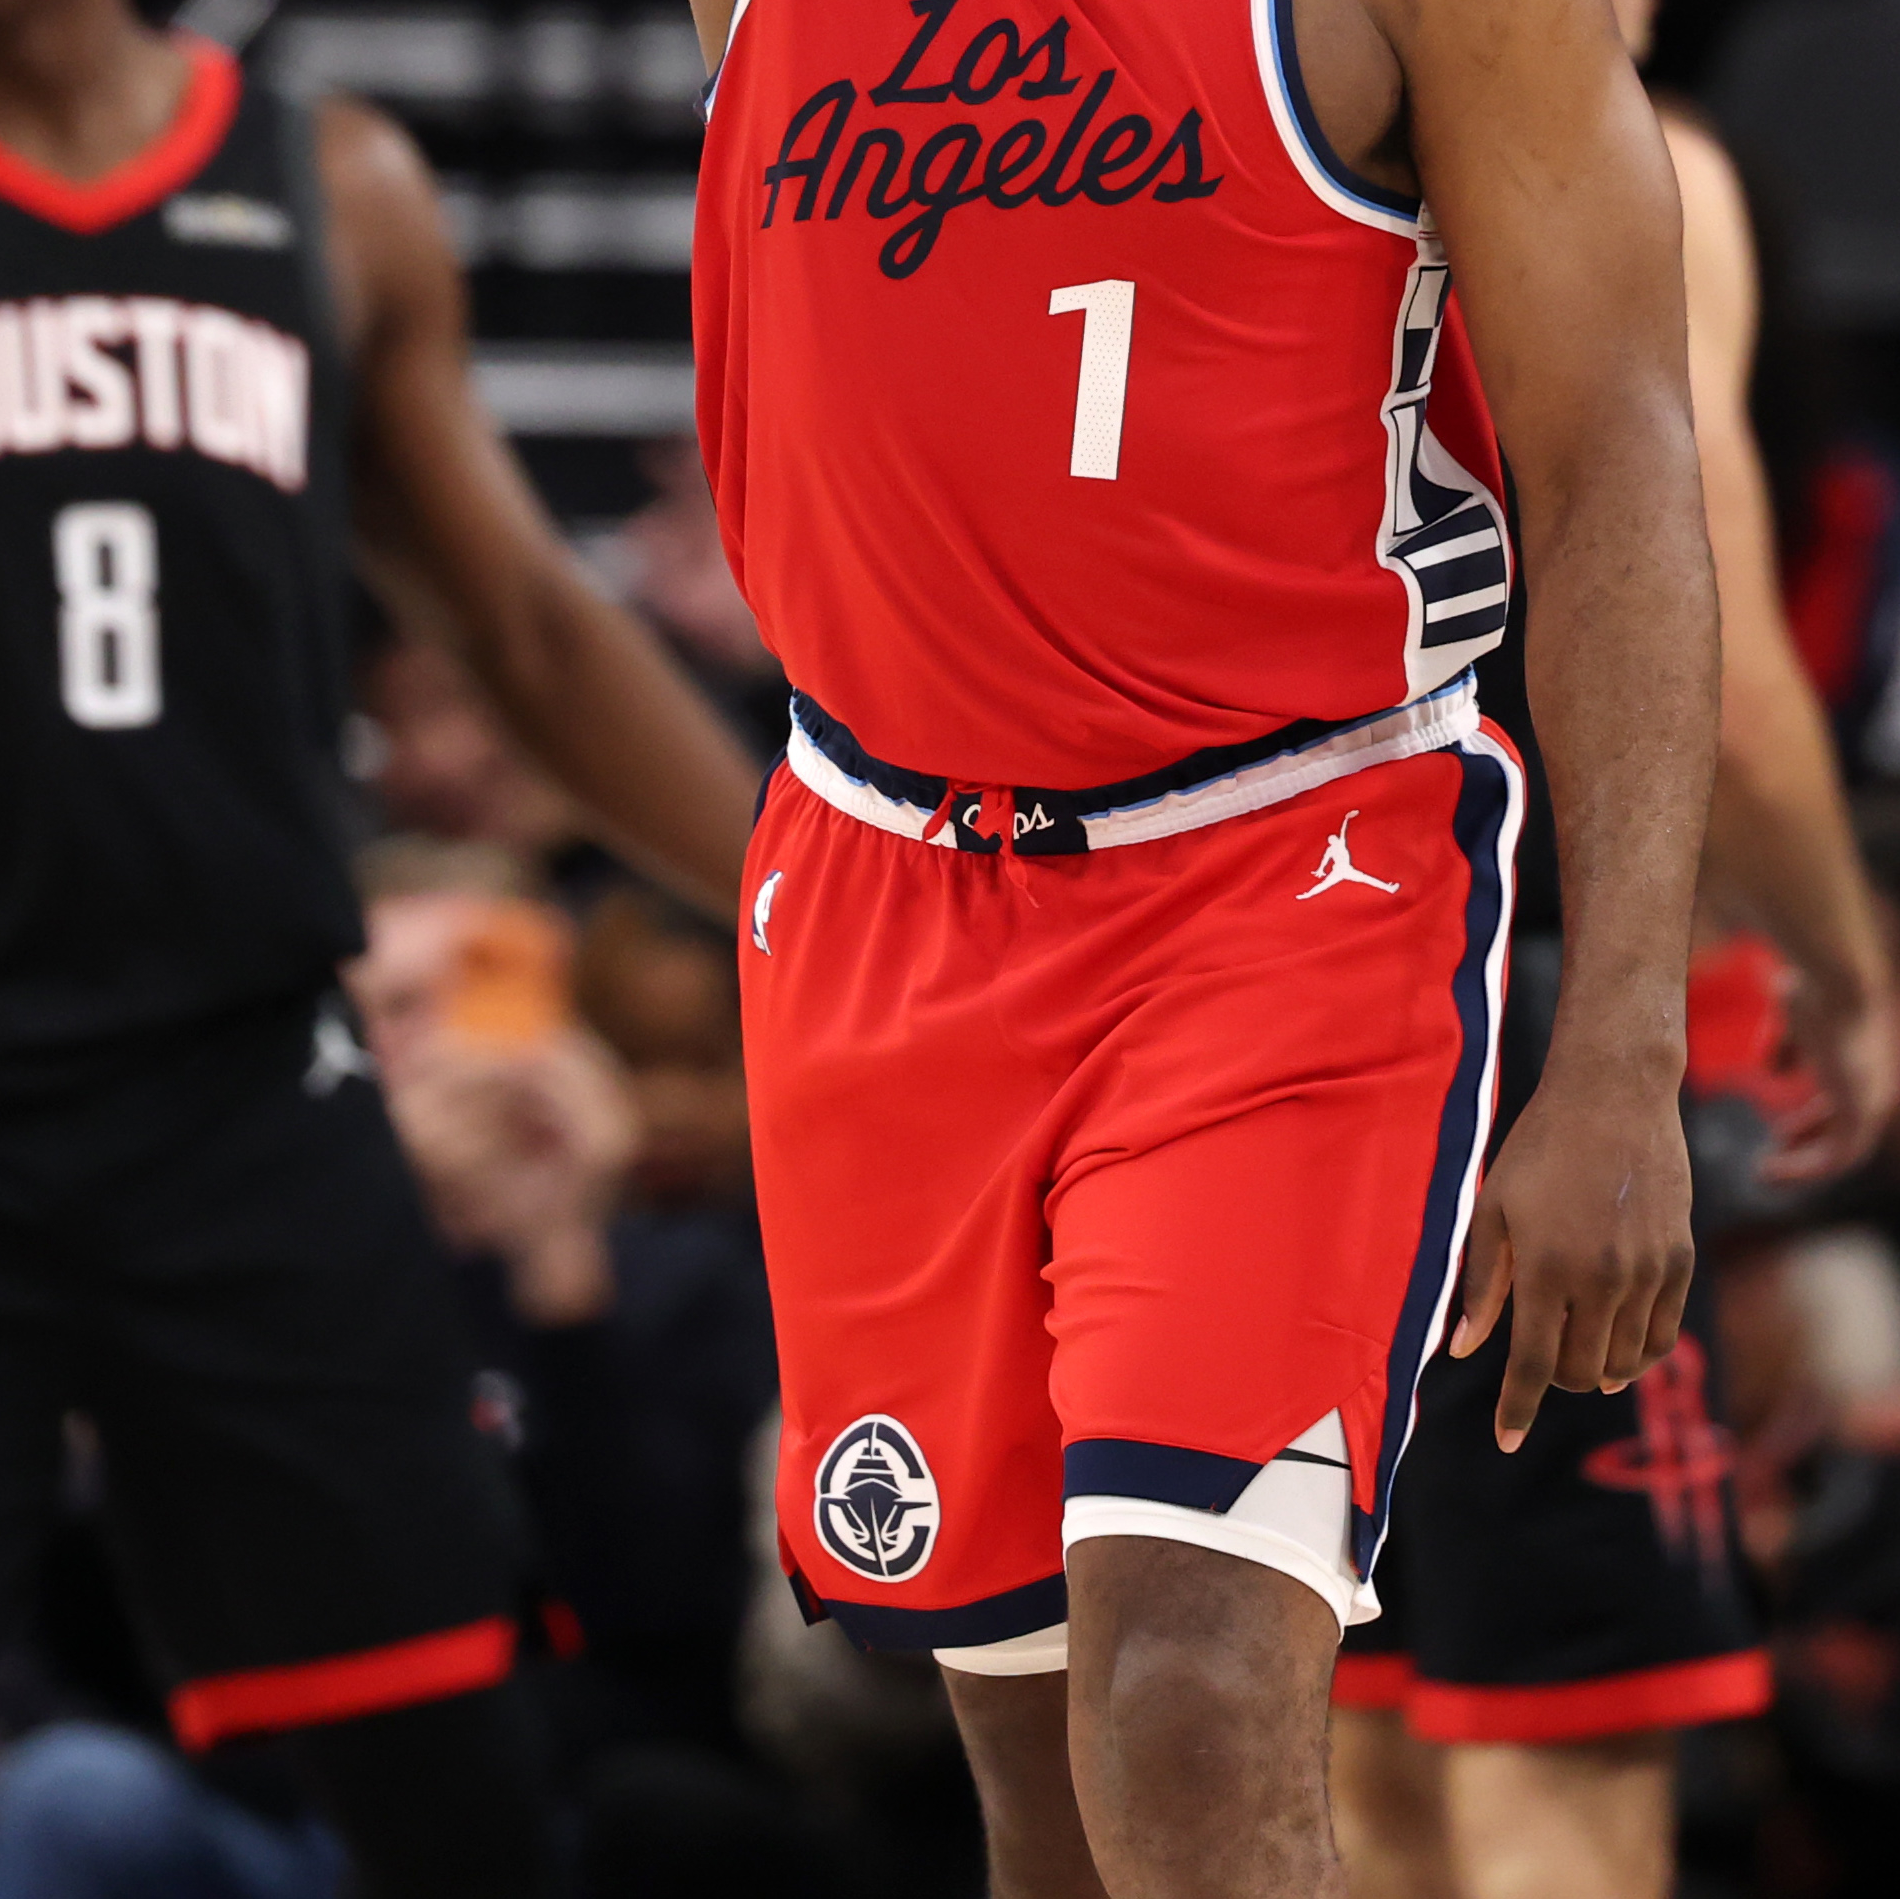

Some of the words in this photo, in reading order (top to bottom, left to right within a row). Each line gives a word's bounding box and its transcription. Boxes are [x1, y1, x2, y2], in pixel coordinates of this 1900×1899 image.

[760, 68, 1223, 281] Angeles
[1047, 278, 1136, 482] 1
[53, 501, 163, 731] 8
[961, 802, 1055, 841] Cps
